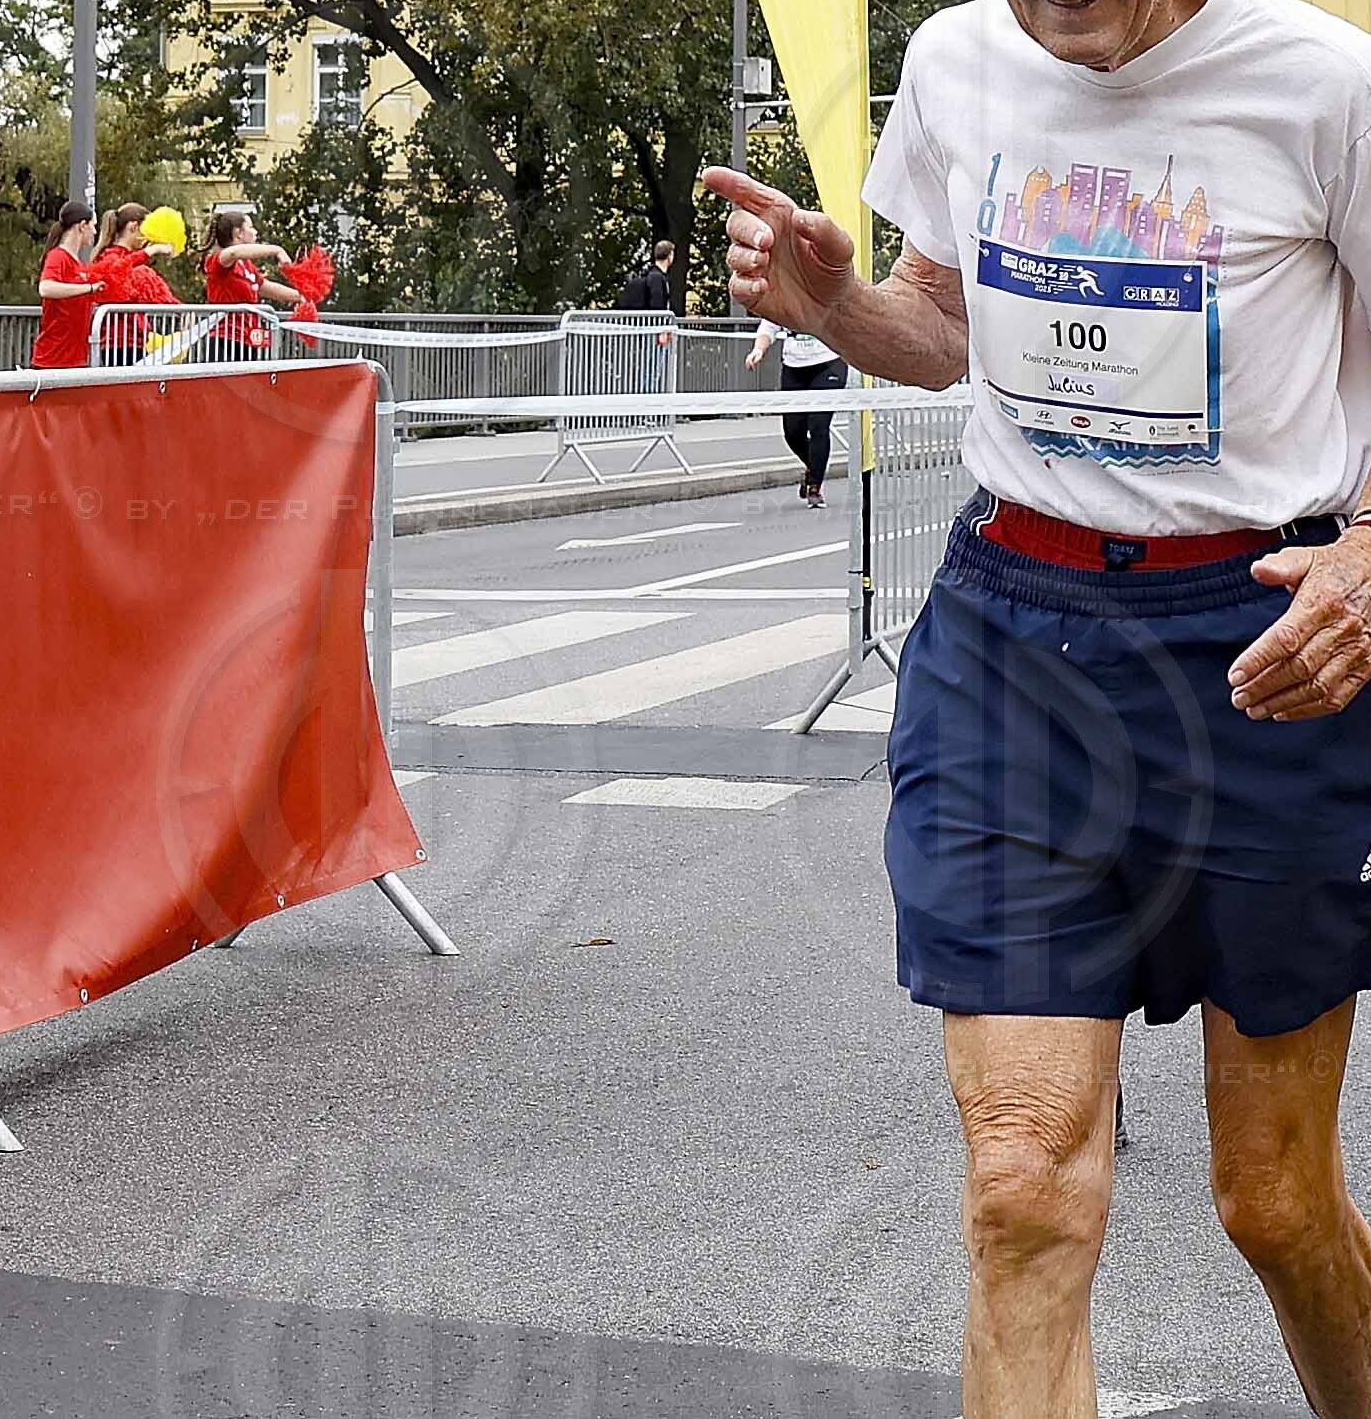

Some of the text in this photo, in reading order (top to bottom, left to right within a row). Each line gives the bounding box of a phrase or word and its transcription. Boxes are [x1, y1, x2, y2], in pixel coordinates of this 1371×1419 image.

[1010, 270, 1046, 285] MARATHON
[1018, 257, 1059, 278] GRAZ
[1124, 285, 1180, 302] GRAZ
[1049, 319, 1107, 352] 100
[1022, 352, 1139, 376] Kleine Zeitung Marathon
[1048, 374, 1095, 396] Julius
